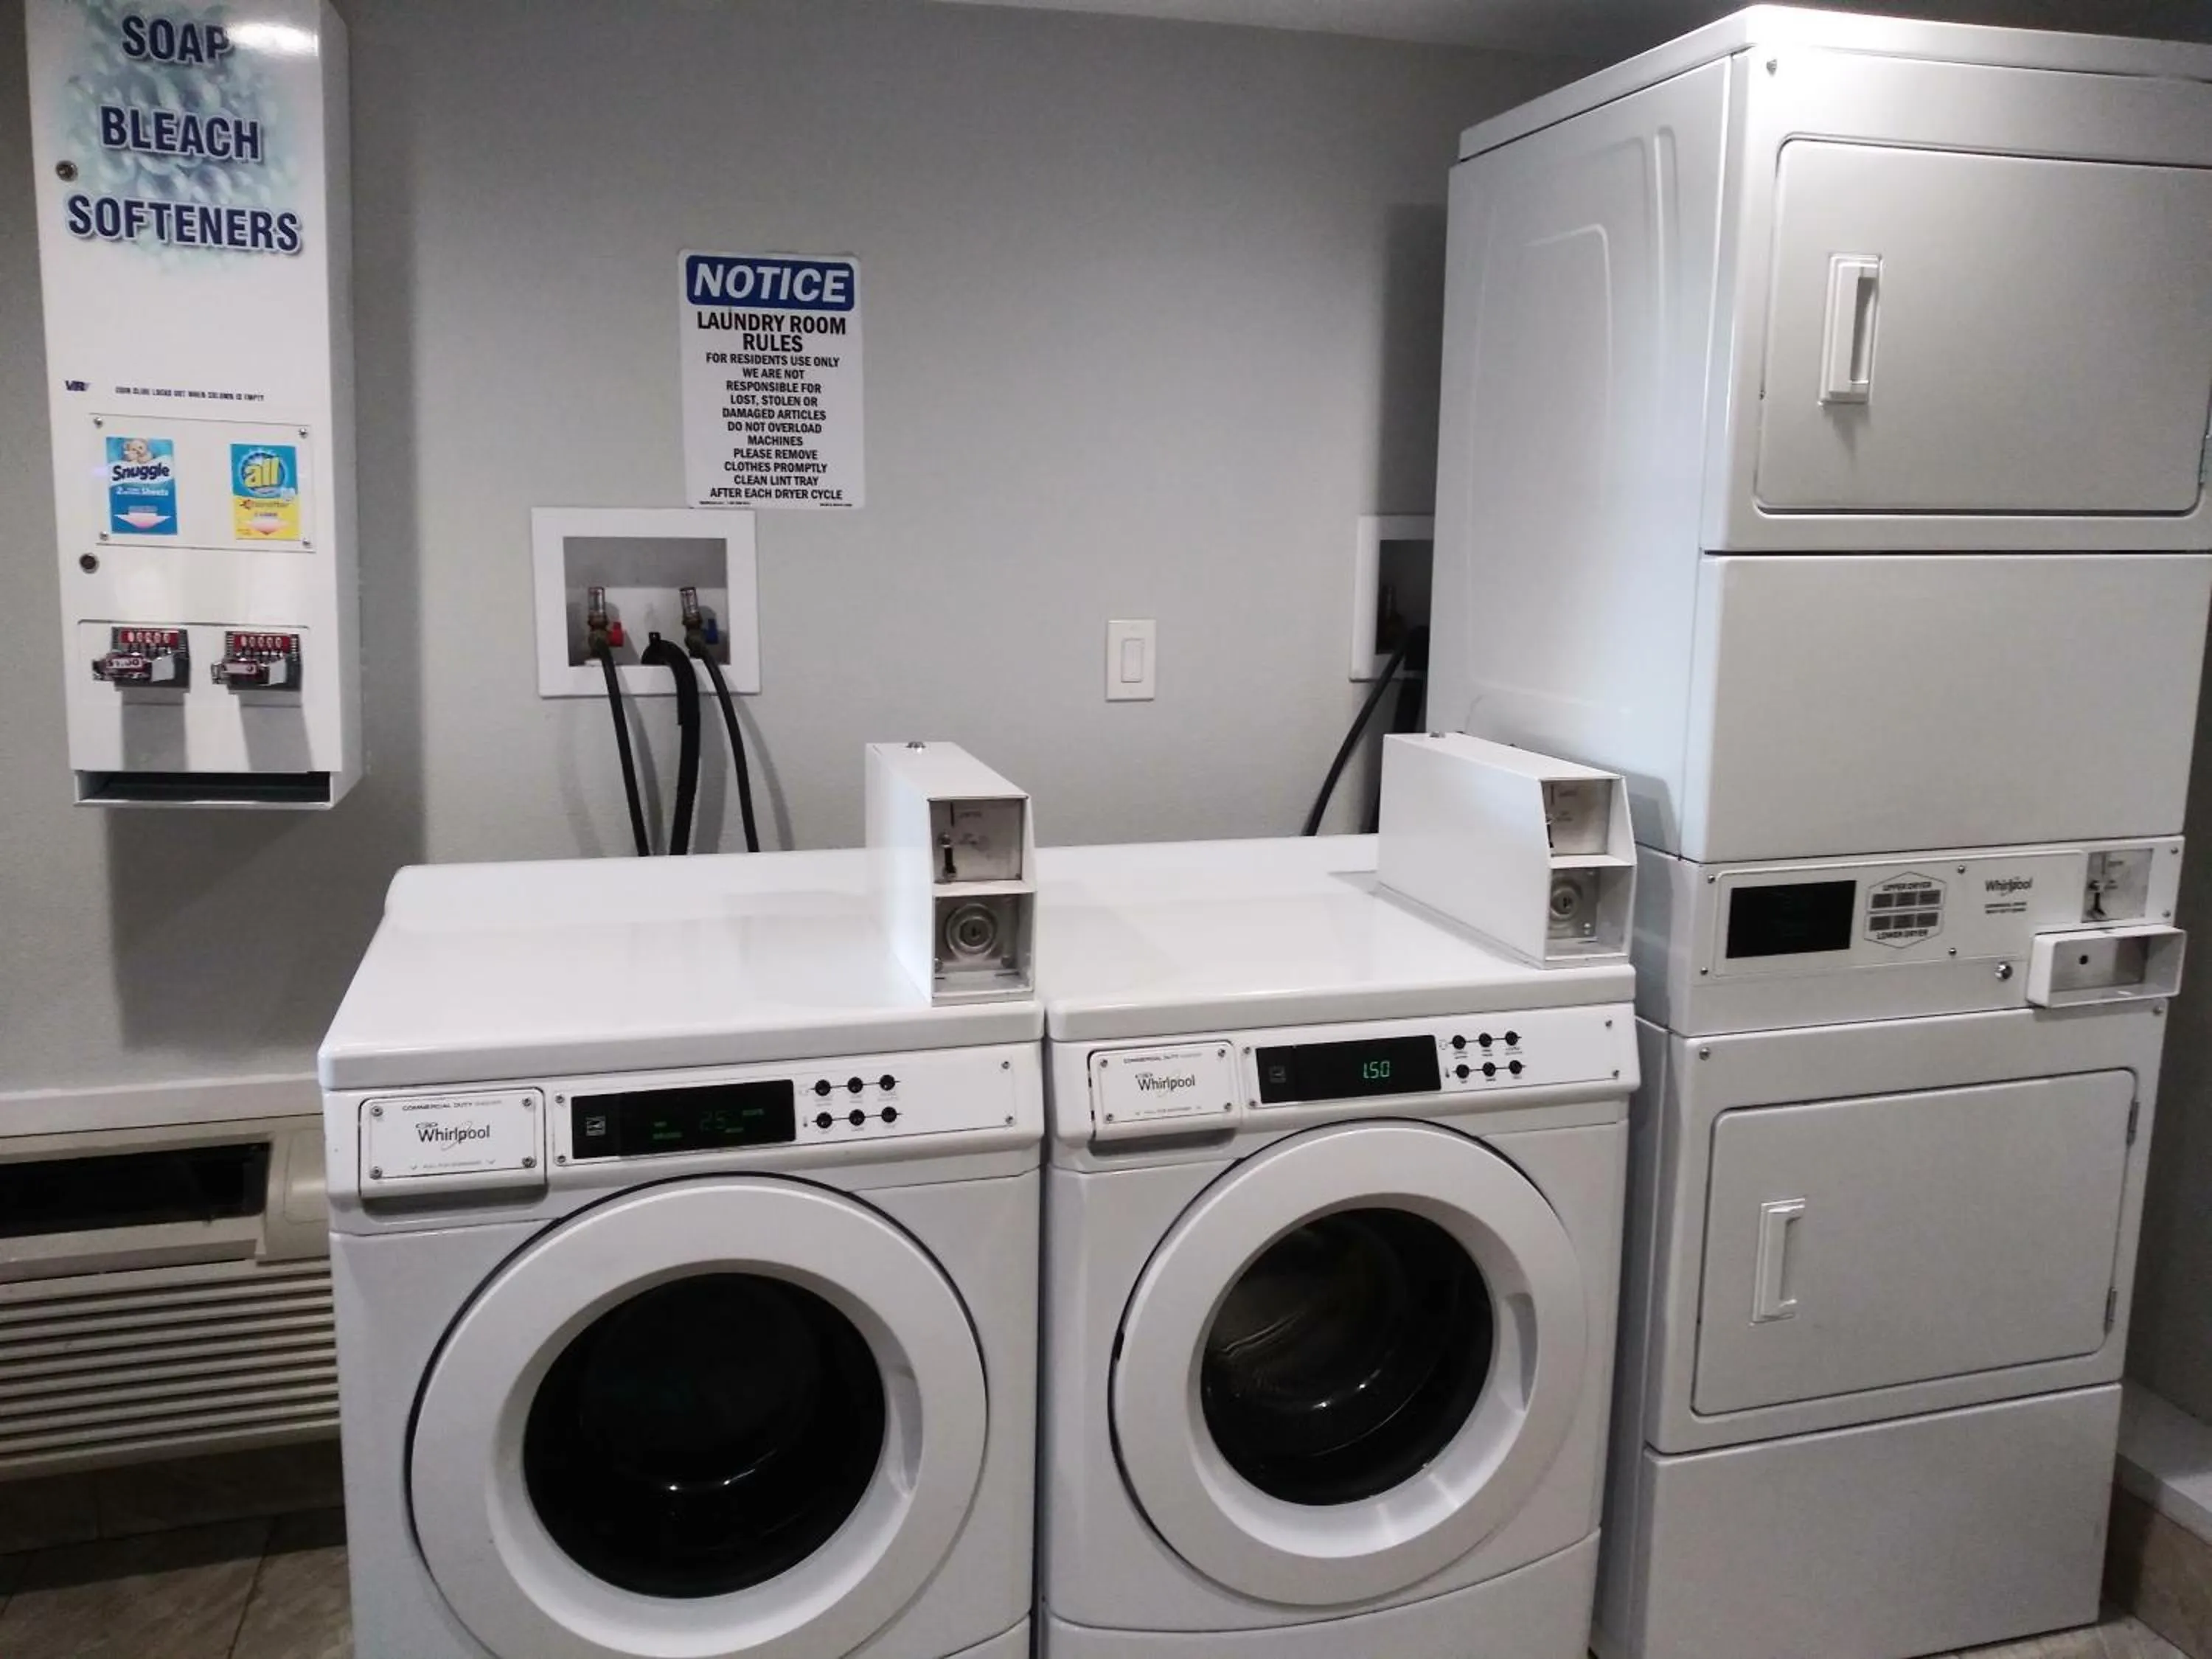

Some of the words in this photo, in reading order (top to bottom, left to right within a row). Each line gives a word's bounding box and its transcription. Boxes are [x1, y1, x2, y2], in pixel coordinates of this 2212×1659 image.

[122, 15, 230, 63] SOAP
[101, 105, 258, 159] BLEACH
[68, 194, 302, 251] SOFTENERS
[694, 263, 849, 303] NOTICE
[698, 311, 785, 332] LAUNDRY
[790, 316, 846, 335] ROOM
[743, 333, 802, 352] RULES
[706, 352, 727, 364] FOR
[730, 353, 787, 366] RESIDENTS
[790, 355, 811, 366] USE
[813, 356, 840, 367] ONLY
[742, 368, 759, 378] WE
[761, 369, 782, 379] ARE
[785, 369, 804, 380] NOT
[726, 380, 799, 393] RESPONSIBLE
[801, 383, 821, 393] FOR
[731, 395, 759, 406] LOST,
[762, 395, 800, 406] STOLEN
[803, 396, 818, 407] OR
[723, 408, 774, 419] DAMAGED
[777, 410, 826, 420] ARTICLES
[728, 421, 742, 431] DO
[745, 422, 765, 432] NOT
[768, 422, 821, 434] OVERLOAD
[748, 435, 803, 446] MACHINES
[734, 448, 772, 459] PLEASE
[775, 449, 818, 459] REMOVE
[112, 462, 170, 481] Snuggle
[244, 456, 279, 487] all
[724, 462, 771, 472] CLOTHES
[774, 462, 827, 473] PROMPTLY
[734, 475, 768, 485] CLEAN
[771, 476, 791, 485] LINT
[793, 476, 818, 486] TRAY
[710, 487, 741, 498] AFTER
[745, 488, 771, 498] EACH
[774, 489, 808, 499] DRYER
[811, 490, 842, 499] CYCLE
[1138, 1074, 1196, 1092] Whirlpool
[417, 1124, 490, 1144] Whirlpool
